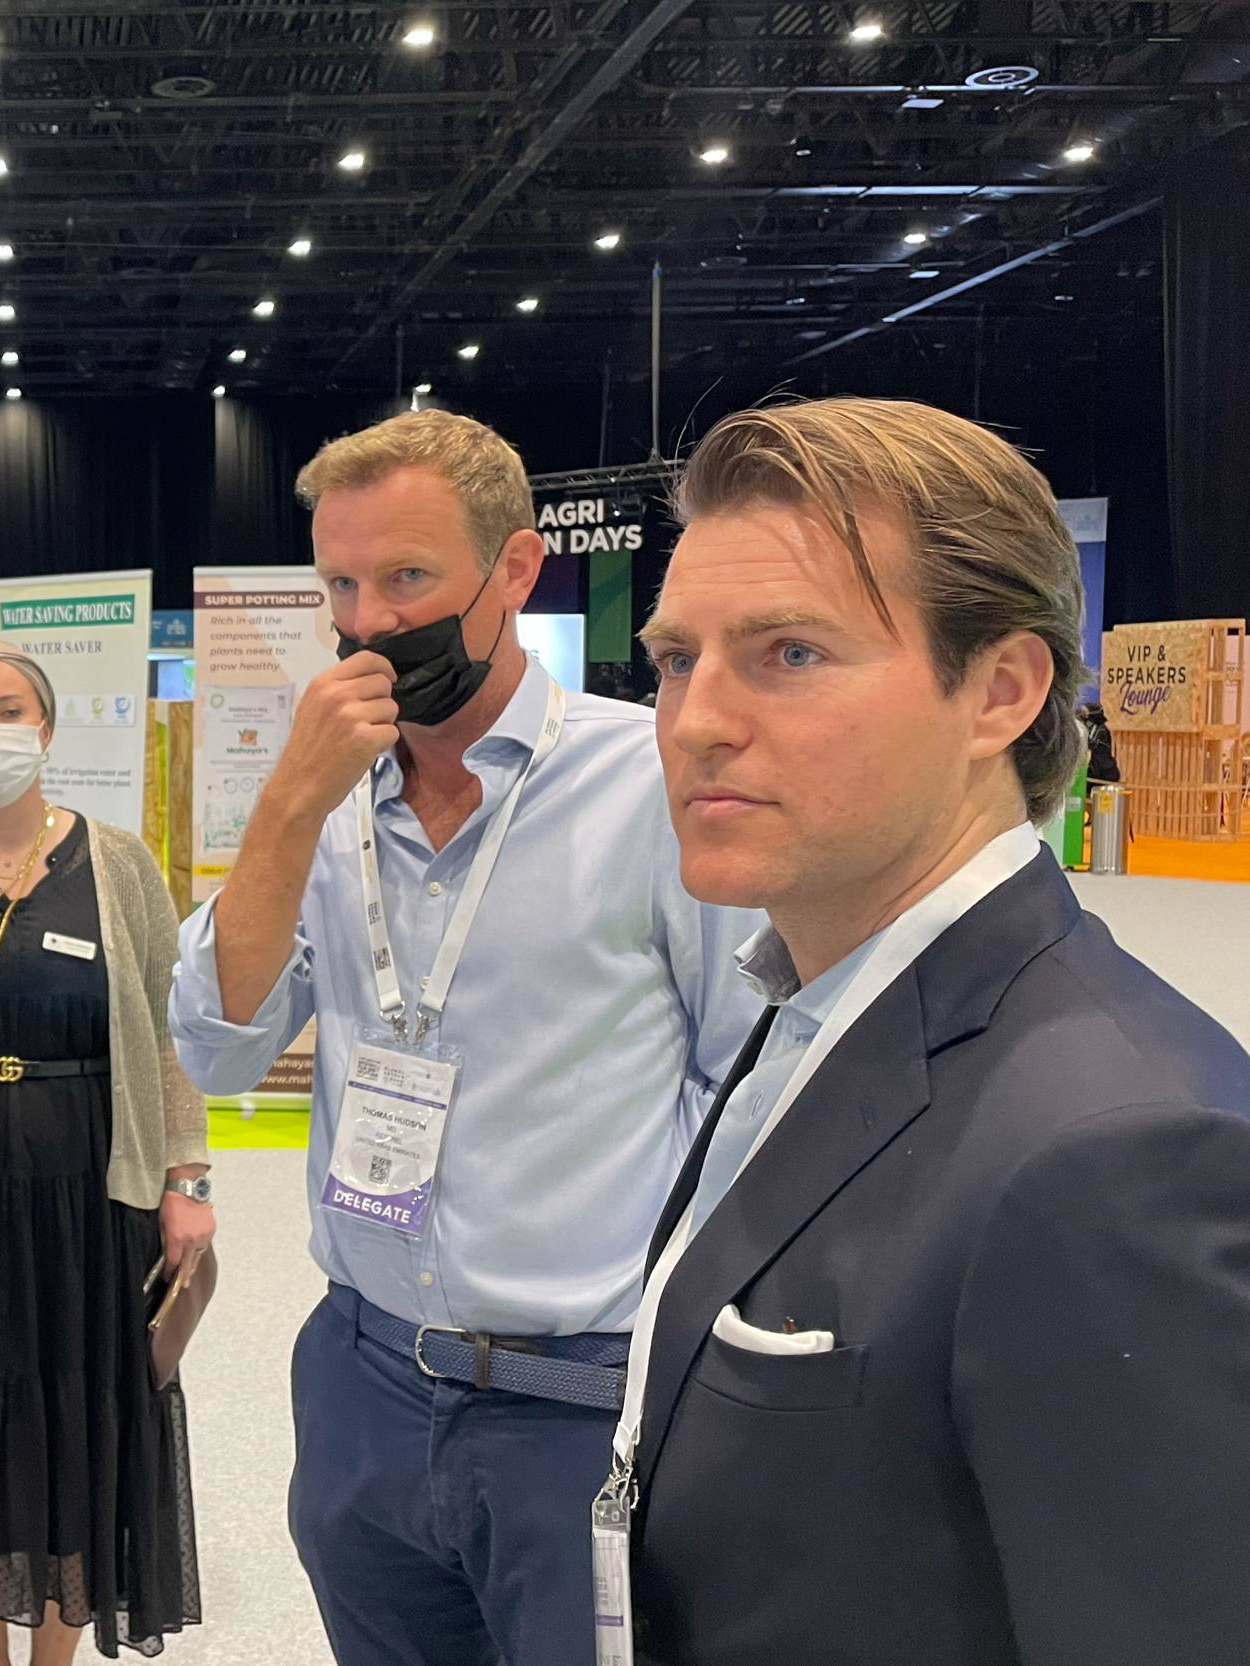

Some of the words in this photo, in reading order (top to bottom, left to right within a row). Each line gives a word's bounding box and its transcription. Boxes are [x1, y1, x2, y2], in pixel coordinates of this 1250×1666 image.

[537, 498, 604, 529] AGRI
[570, 524, 643, 554] DAYS
[204, 595, 244, 606] SUPER
[245, 594, 297, 605] POTTING
[298, 594, 321, 604] MIX
[2, 607, 33, 625] WATER
[35, 605, 73, 624] SAVING
[75, 601, 132, 622] PRODUCTS
[210, 615, 233, 625] Rich
[236, 615, 246, 625] in
[248, 615, 262, 625] all
[264, 616, 282, 625] the
[209, 631, 276, 641] components
[279, 631, 302, 640] that
[21, 642, 62, 655] WATER
[65, 640, 102, 654] SAVER
[209, 646, 243, 657] plants
[245, 646, 272, 656] need
[275, 647, 286, 656] to
[1127, 645, 1151, 662] VIP
[1157, 645, 1166, 662] &
[209, 662, 237, 673] grow
[239, 662, 280, 672] healthy
[1107, 666, 1187, 684] SPEAKERS
[1120, 680, 1171, 715] Lounge
[362, 1106, 393, 1121] THOMAS
[394, 1115, 427, 1131] HUDSON
[333, 1189, 412, 1224] DELEGATE
